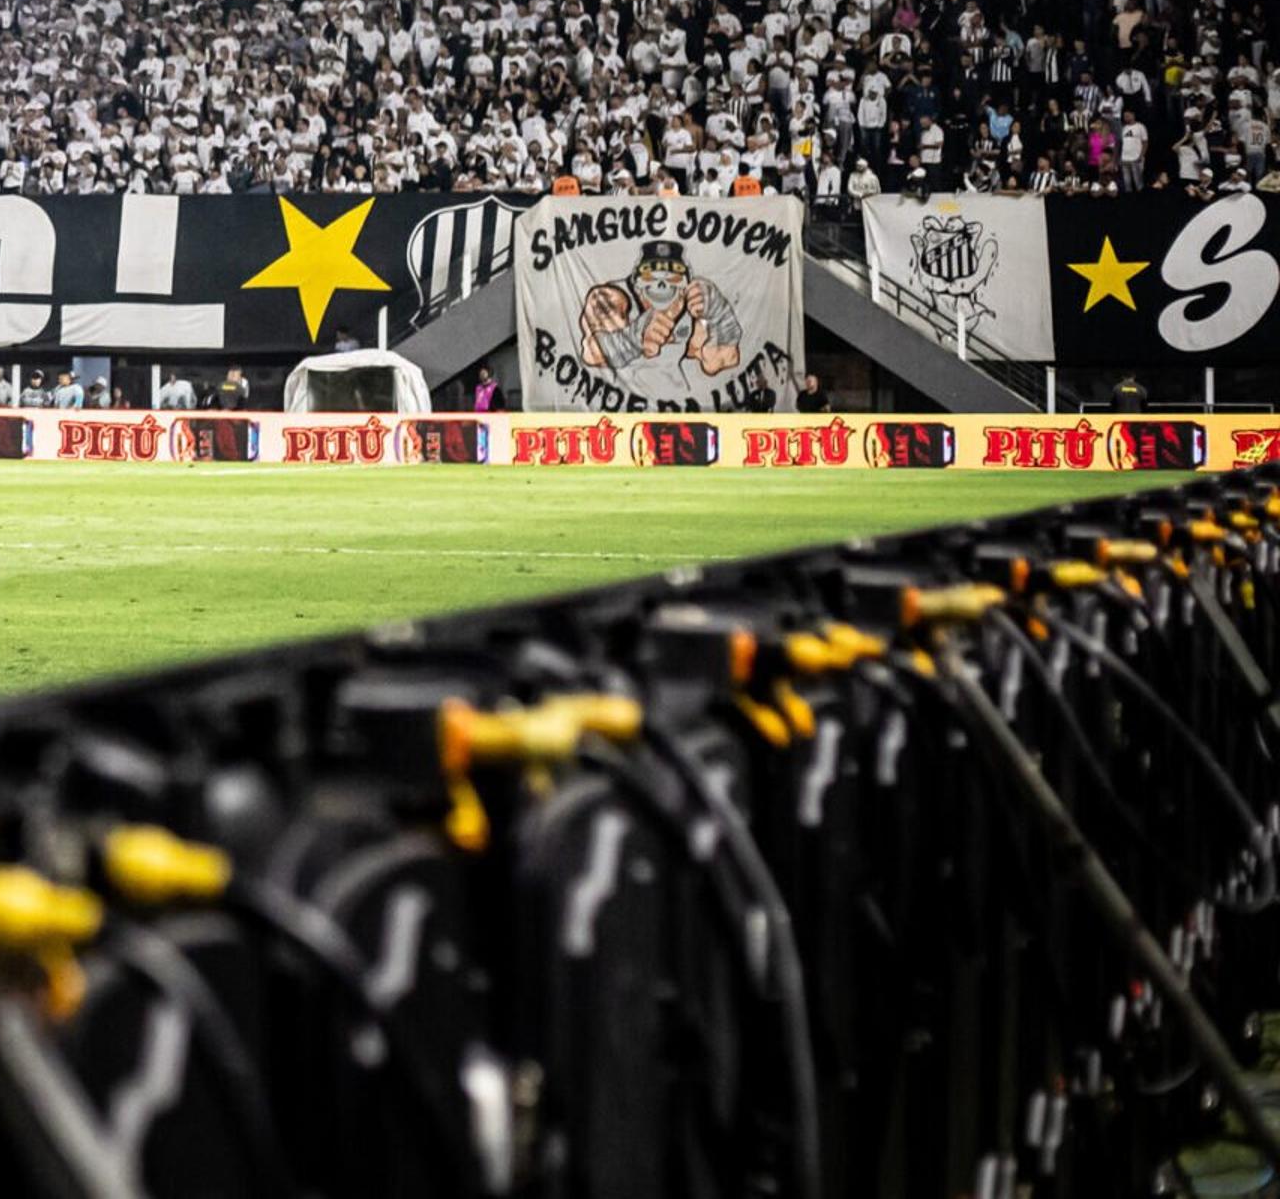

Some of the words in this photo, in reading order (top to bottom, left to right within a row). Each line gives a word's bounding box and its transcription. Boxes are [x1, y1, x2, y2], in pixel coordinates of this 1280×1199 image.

[59, 415, 166, 462] PITÚ
[283, 416, 391, 464] PITÚ
[512, 416, 622, 466] PITÚ
[743, 416, 855, 468] PITÚ
[983, 418, 1102, 469] PITÚ
